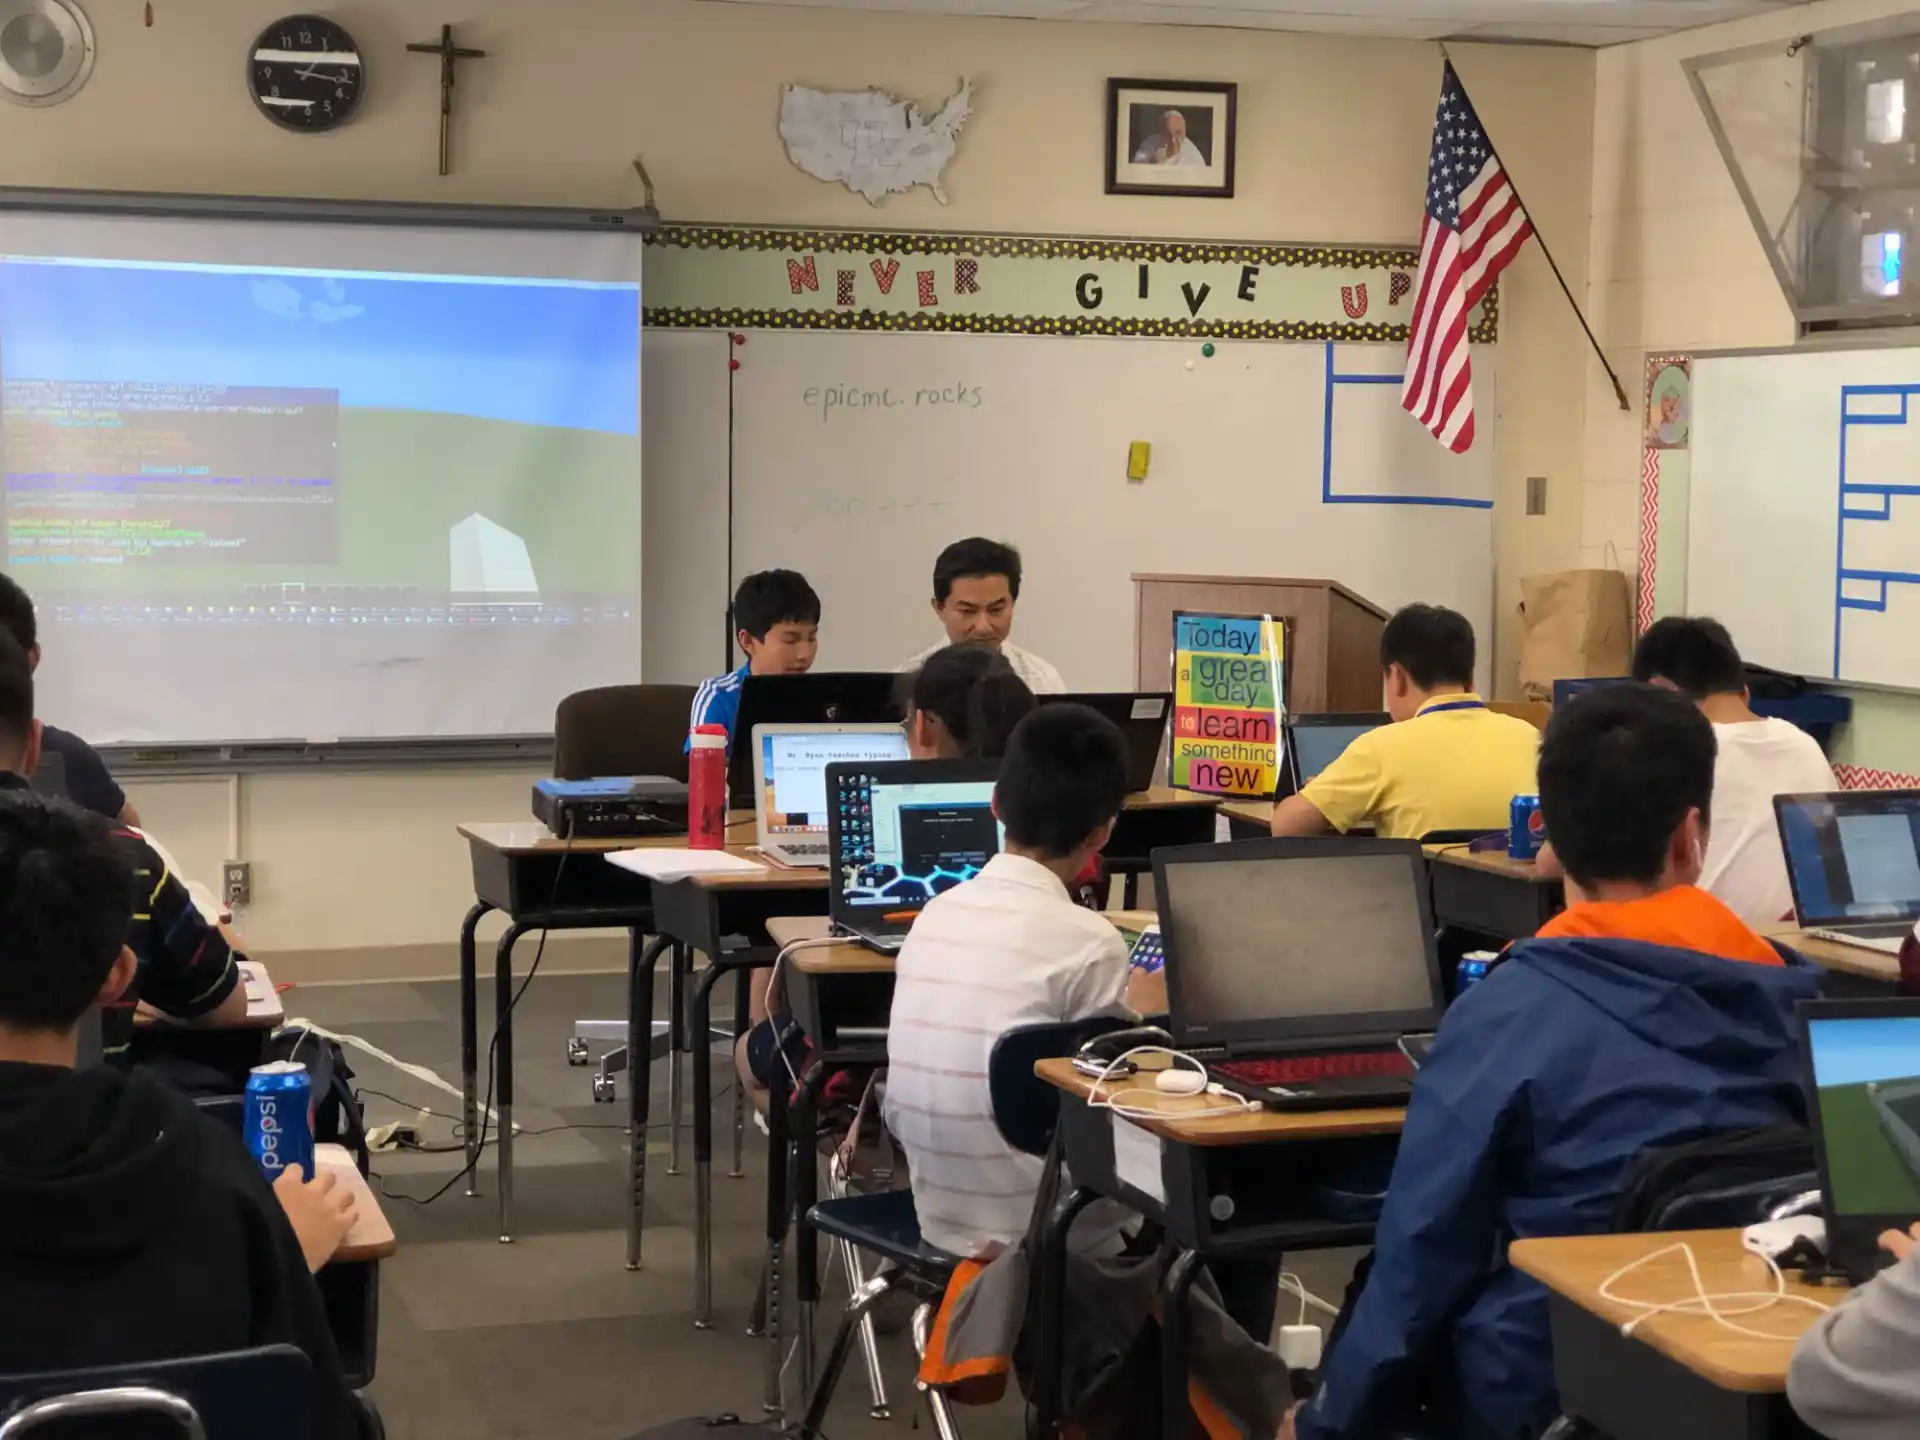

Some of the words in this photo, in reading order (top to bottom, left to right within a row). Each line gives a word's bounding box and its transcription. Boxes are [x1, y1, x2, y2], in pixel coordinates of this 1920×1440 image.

[281, 35, 292, 48] 11
[299, 31, 312, 45] 12
[264, 66, 272, 80] 9
[304, 103, 312, 116] 6
[323, 99, 332, 113] 5
[786, 255, 981, 308] NEVER
[1075, 264, 1260, 319] GIVE
[1341, 271, 1413, 320] UP
[1182, 621, 1258, 656] Today
[1180, 668, 1190, 681] a
[1200, 658, 1274, 688] grea
[1214, 678, 1260, 709] day
[1180, 714, 1196, 730] to
[1196, 708, 1270, 741] learn
[1181, 743, 1277, 768] something
[1196, 763, 1260, 789] new
[256, 1095, 285, 1169] pepsi
